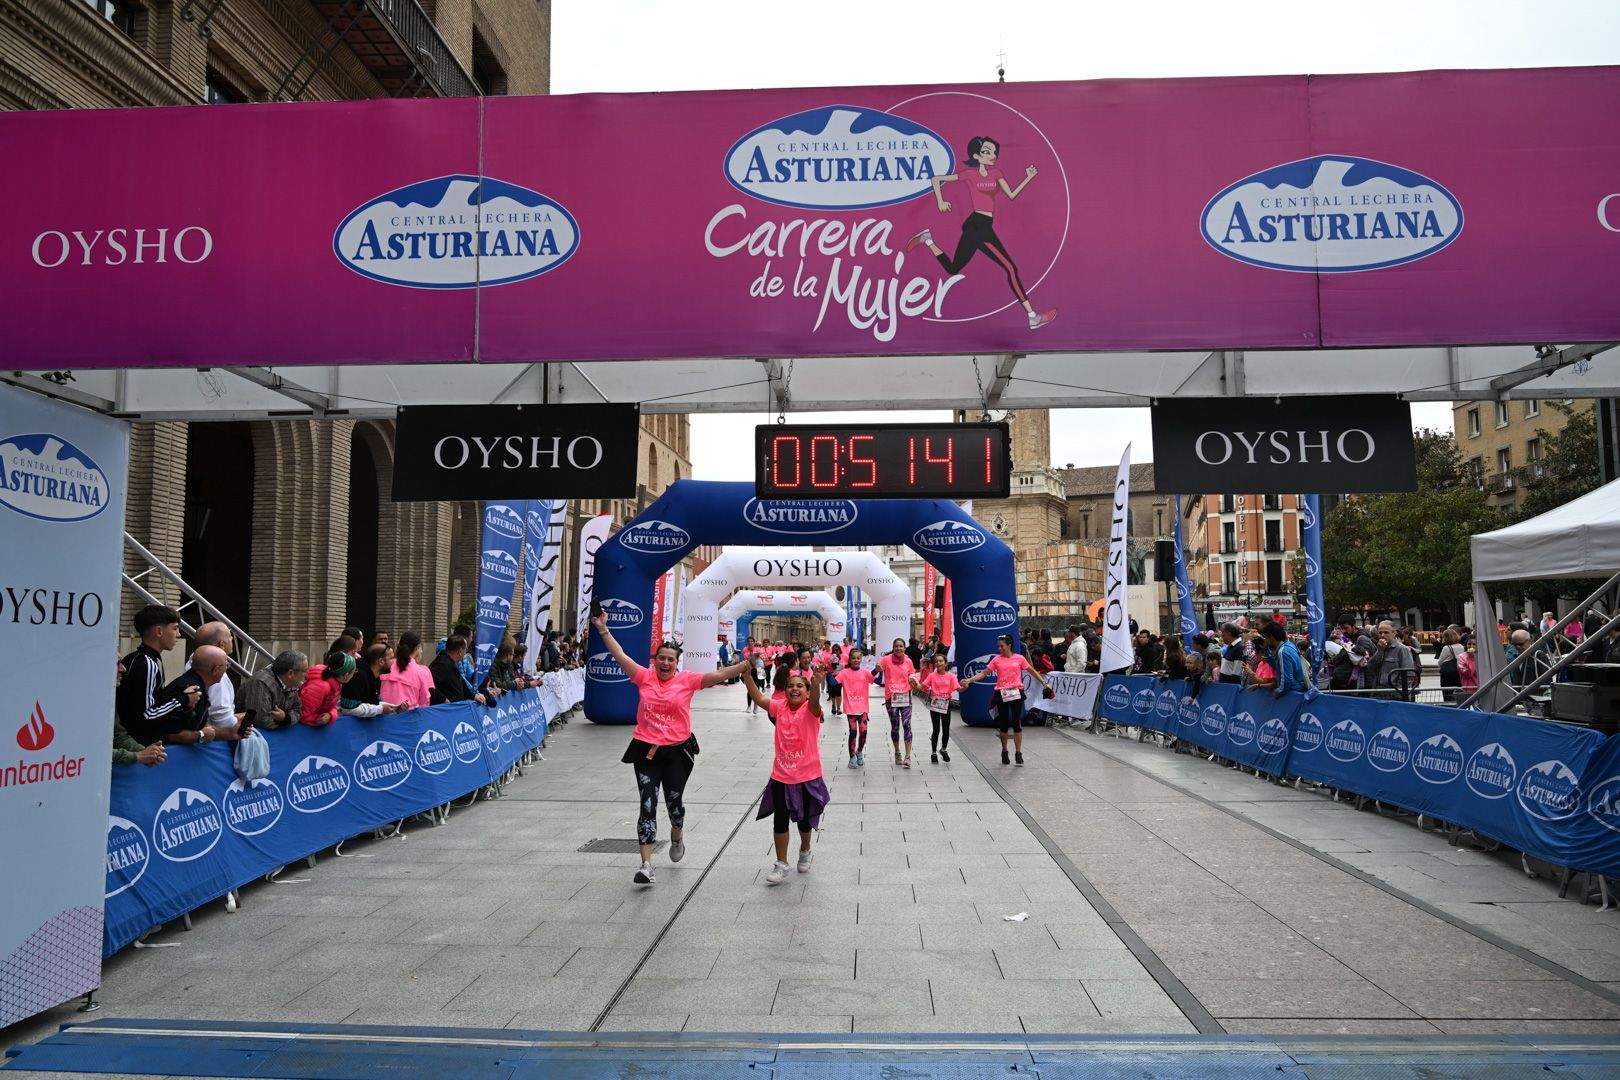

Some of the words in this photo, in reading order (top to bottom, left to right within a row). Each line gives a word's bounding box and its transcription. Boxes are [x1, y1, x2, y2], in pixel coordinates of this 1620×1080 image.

[777, 140, 849, 152] CENTRAL
[856, 139, 930, 151] LECHERA
[741, 145, 937, 184] ASTURIANA
[1260, 195, 1342, 208] CENTRAL
[1350, 193, 1434, 206] LECHERA
[390, 213, 467, 227] CENTRAL
[474, 211, 553, 225] LECHERA
[704, 204, 893, 258] Carrera
[1221, 201, 1444, 244] ASTURIANA
[31, 226, 214, 268] OYSHO
[352, 218, 560, 262] ASTURIANA
[749, 261, 785, 298] de
[793, 259, 818, 298] la
[812, 251, 966, 342] Mujer
[433, 435, 603, 470] OYSHO
[1195, 429, 1376, 465] OYSHO
[13, 456, 56, 474] CENTRAL
[60, 466, 99, 483] LECHERA
[751, 500, 849, 523] ASTURIANA
[623, 531, 684, 546] ASTURIANA
[919, 533, 981, 546] ASTURIANA
[753, 558, 843, 577] OYSHO
[700, 578, 728, 586] OYSHO
[0, 586, 104, 628] YSHO
[964, 611, 1014, 623] ASTURIANA
[1327, 732, 1362, 754] ASTURIANA
[1369, 740, 1406, 763] ASTURIANA
[420, 747, 451, 767] ASTURIANA
[1414, 749, 1458, 775] ASTURIANA
[0, 755, 85, 788] ntander
[359, 759, 410, 784] ASTURIANA
[292, 775, 347, 805] ASTURIANA
[229, 795, 280, 825] ASTURIANA
[160, 813, 220, 852] ASTURIANA
